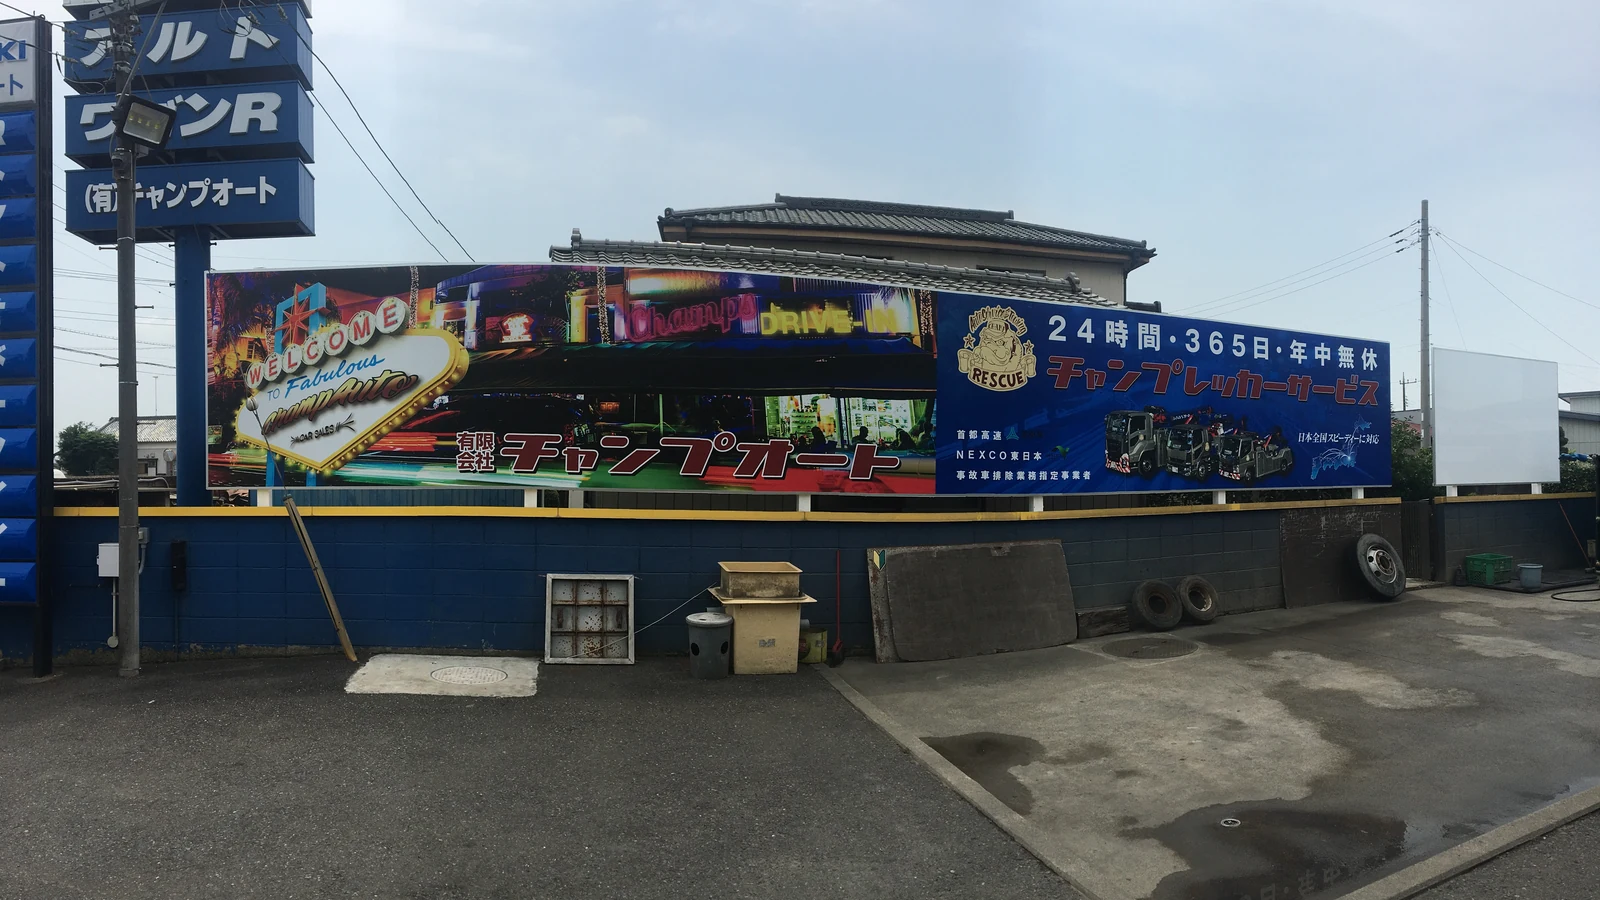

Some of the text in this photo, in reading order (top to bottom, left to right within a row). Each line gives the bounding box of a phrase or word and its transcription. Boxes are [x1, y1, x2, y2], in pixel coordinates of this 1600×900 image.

[0, 74, 24, 96] ト
[79, 92, 283, 142] ワンR
[760, 306, 898, 336] DRIVE-IN
[249, 302, 400, 386] WELCOME
[1048, 315, 1379, 371] 24時間・365日・年中無休
[284, 353, 386, 399] Fabulous
[972, 367, 1025, 388] RESCUE
[1047, 355, 1380, 405] チャンプレッカーサービス
[456, 431, 495, 452] 有限
[956, 430, 1002, 441] 首都高速
[1298, 432, 1380, 445] 日本全国スピーディーに対応
[456, 452, 495, 473] 会社
[500, 431, 901, 482] チャンプオート
[956, 449, 1042, 461] NEXCO東日本
